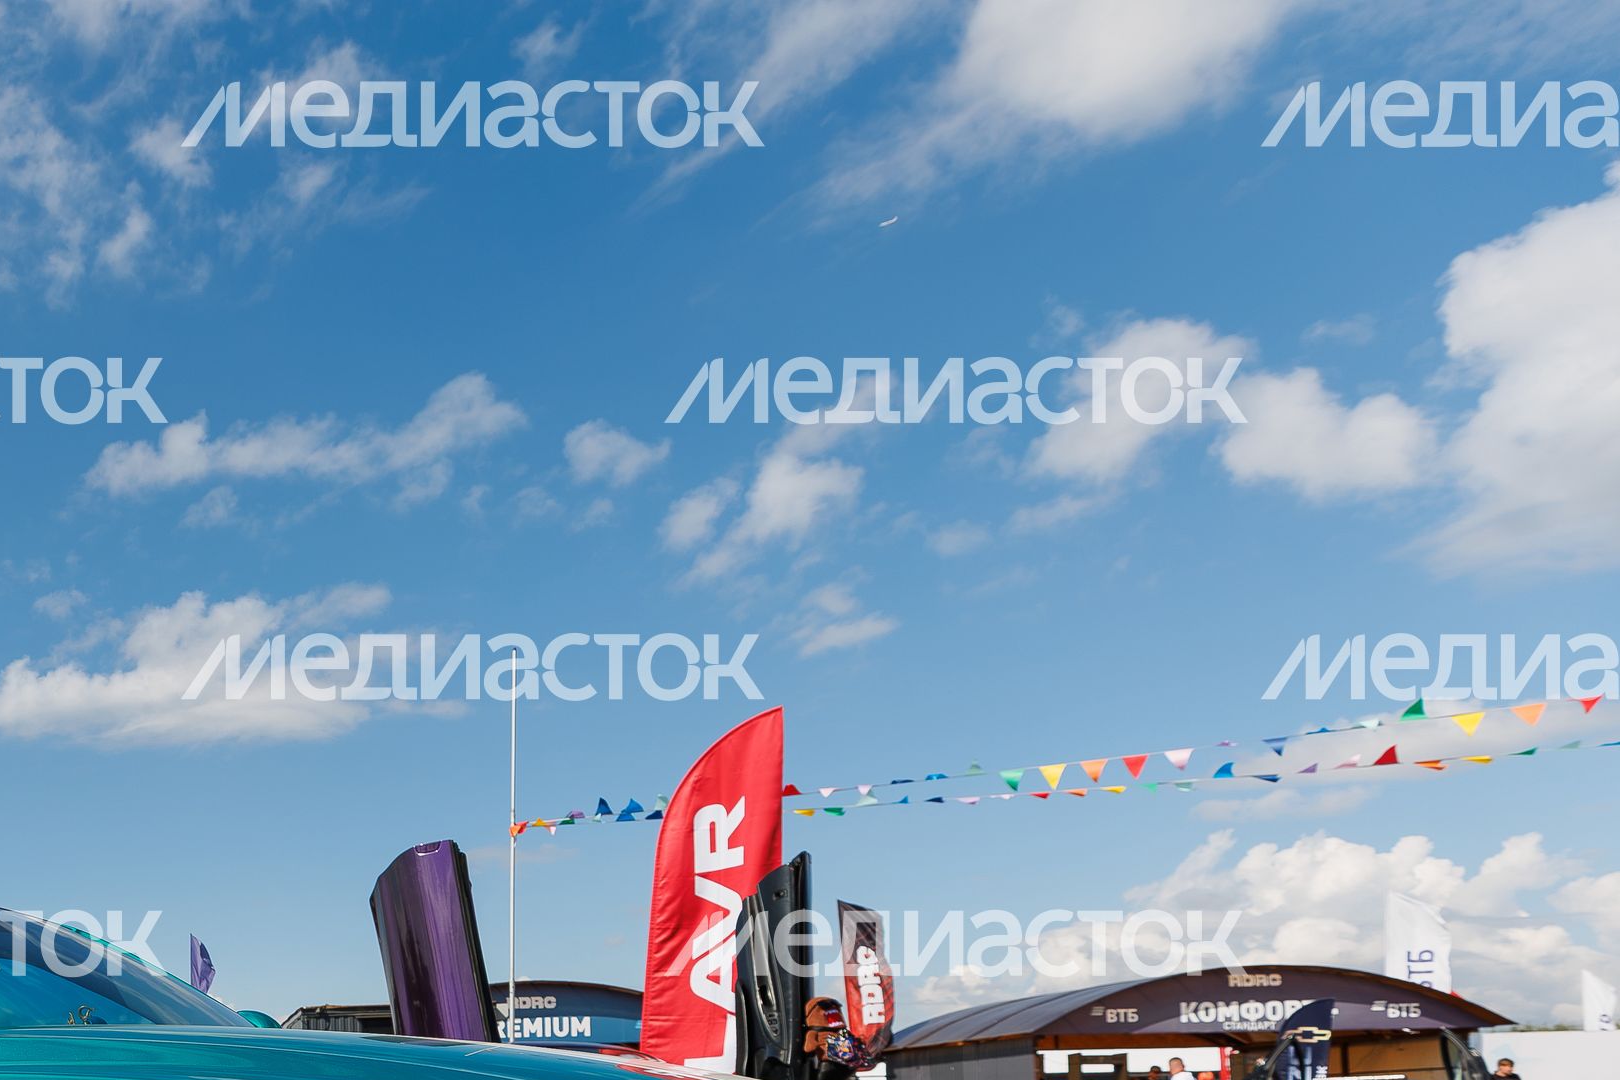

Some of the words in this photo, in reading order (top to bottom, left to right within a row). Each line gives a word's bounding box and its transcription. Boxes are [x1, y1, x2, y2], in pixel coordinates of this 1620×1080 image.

[1105, 1008, 1139, 1024] ВТБ
[1387, 1003, 1421, 1018] ВТБ
[496, 1016, 591, 1038] REMIUM
